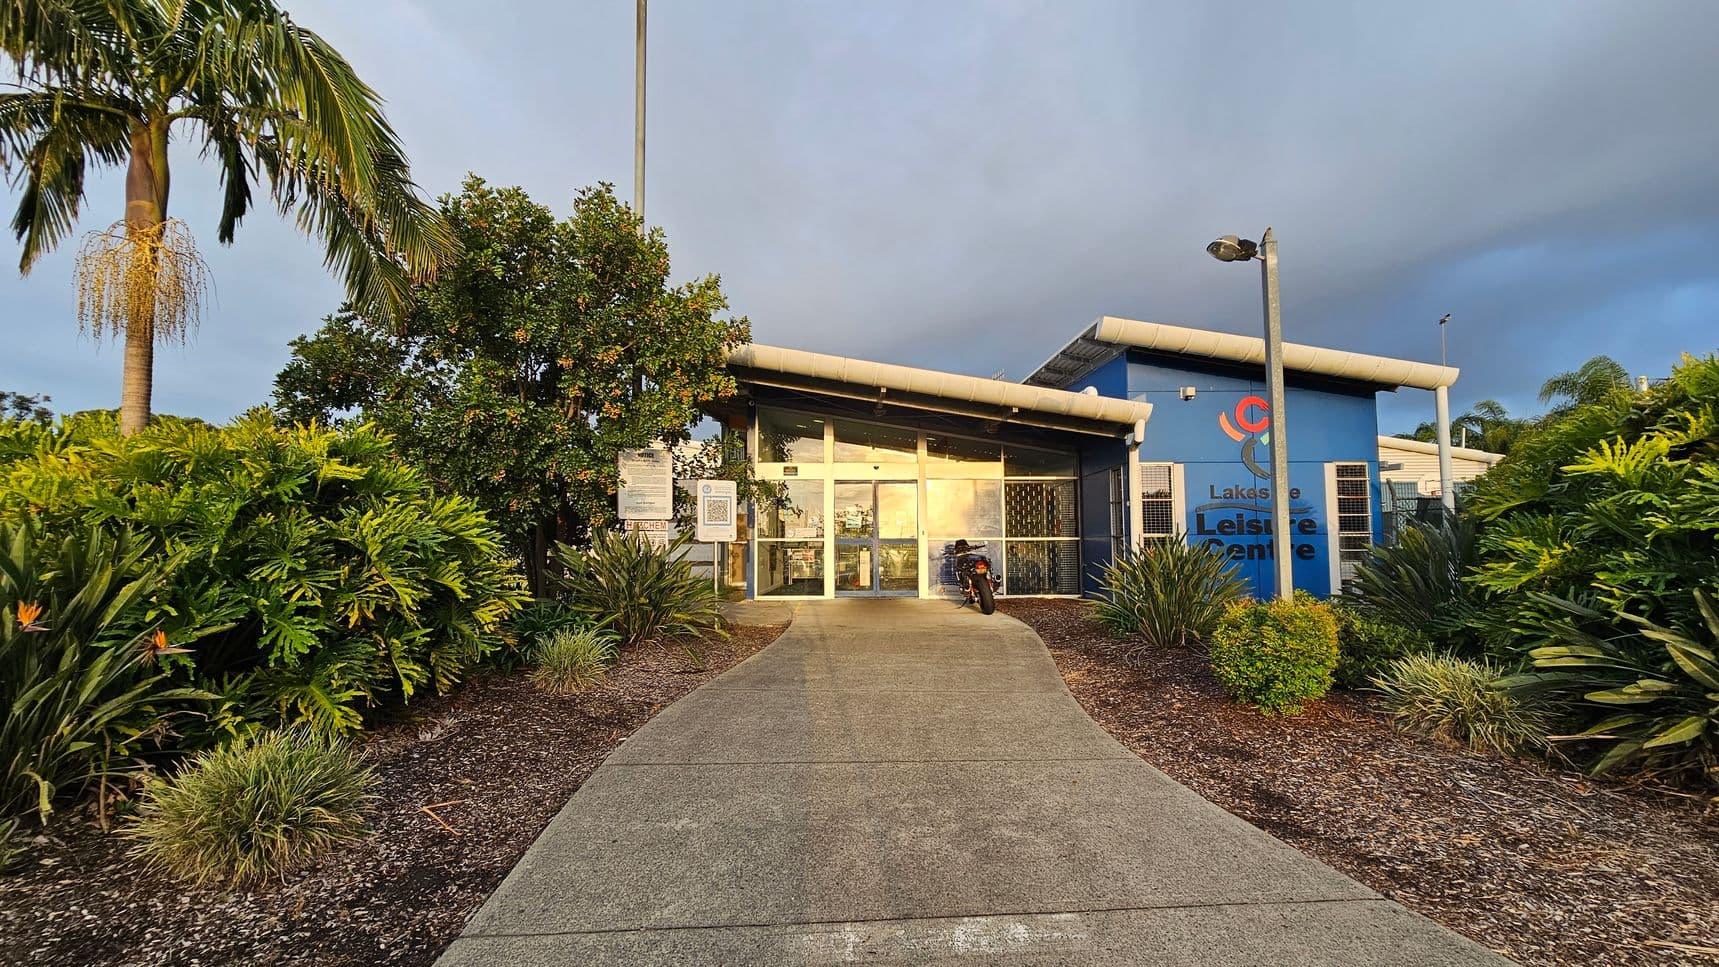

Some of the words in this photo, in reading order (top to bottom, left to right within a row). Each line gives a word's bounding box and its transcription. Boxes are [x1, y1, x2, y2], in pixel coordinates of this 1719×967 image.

[1209, 484, 1301, 499] Lakese
[626, 521, 667, 530] HZCHEM
[1201, 538, 1316, 560] Cene
